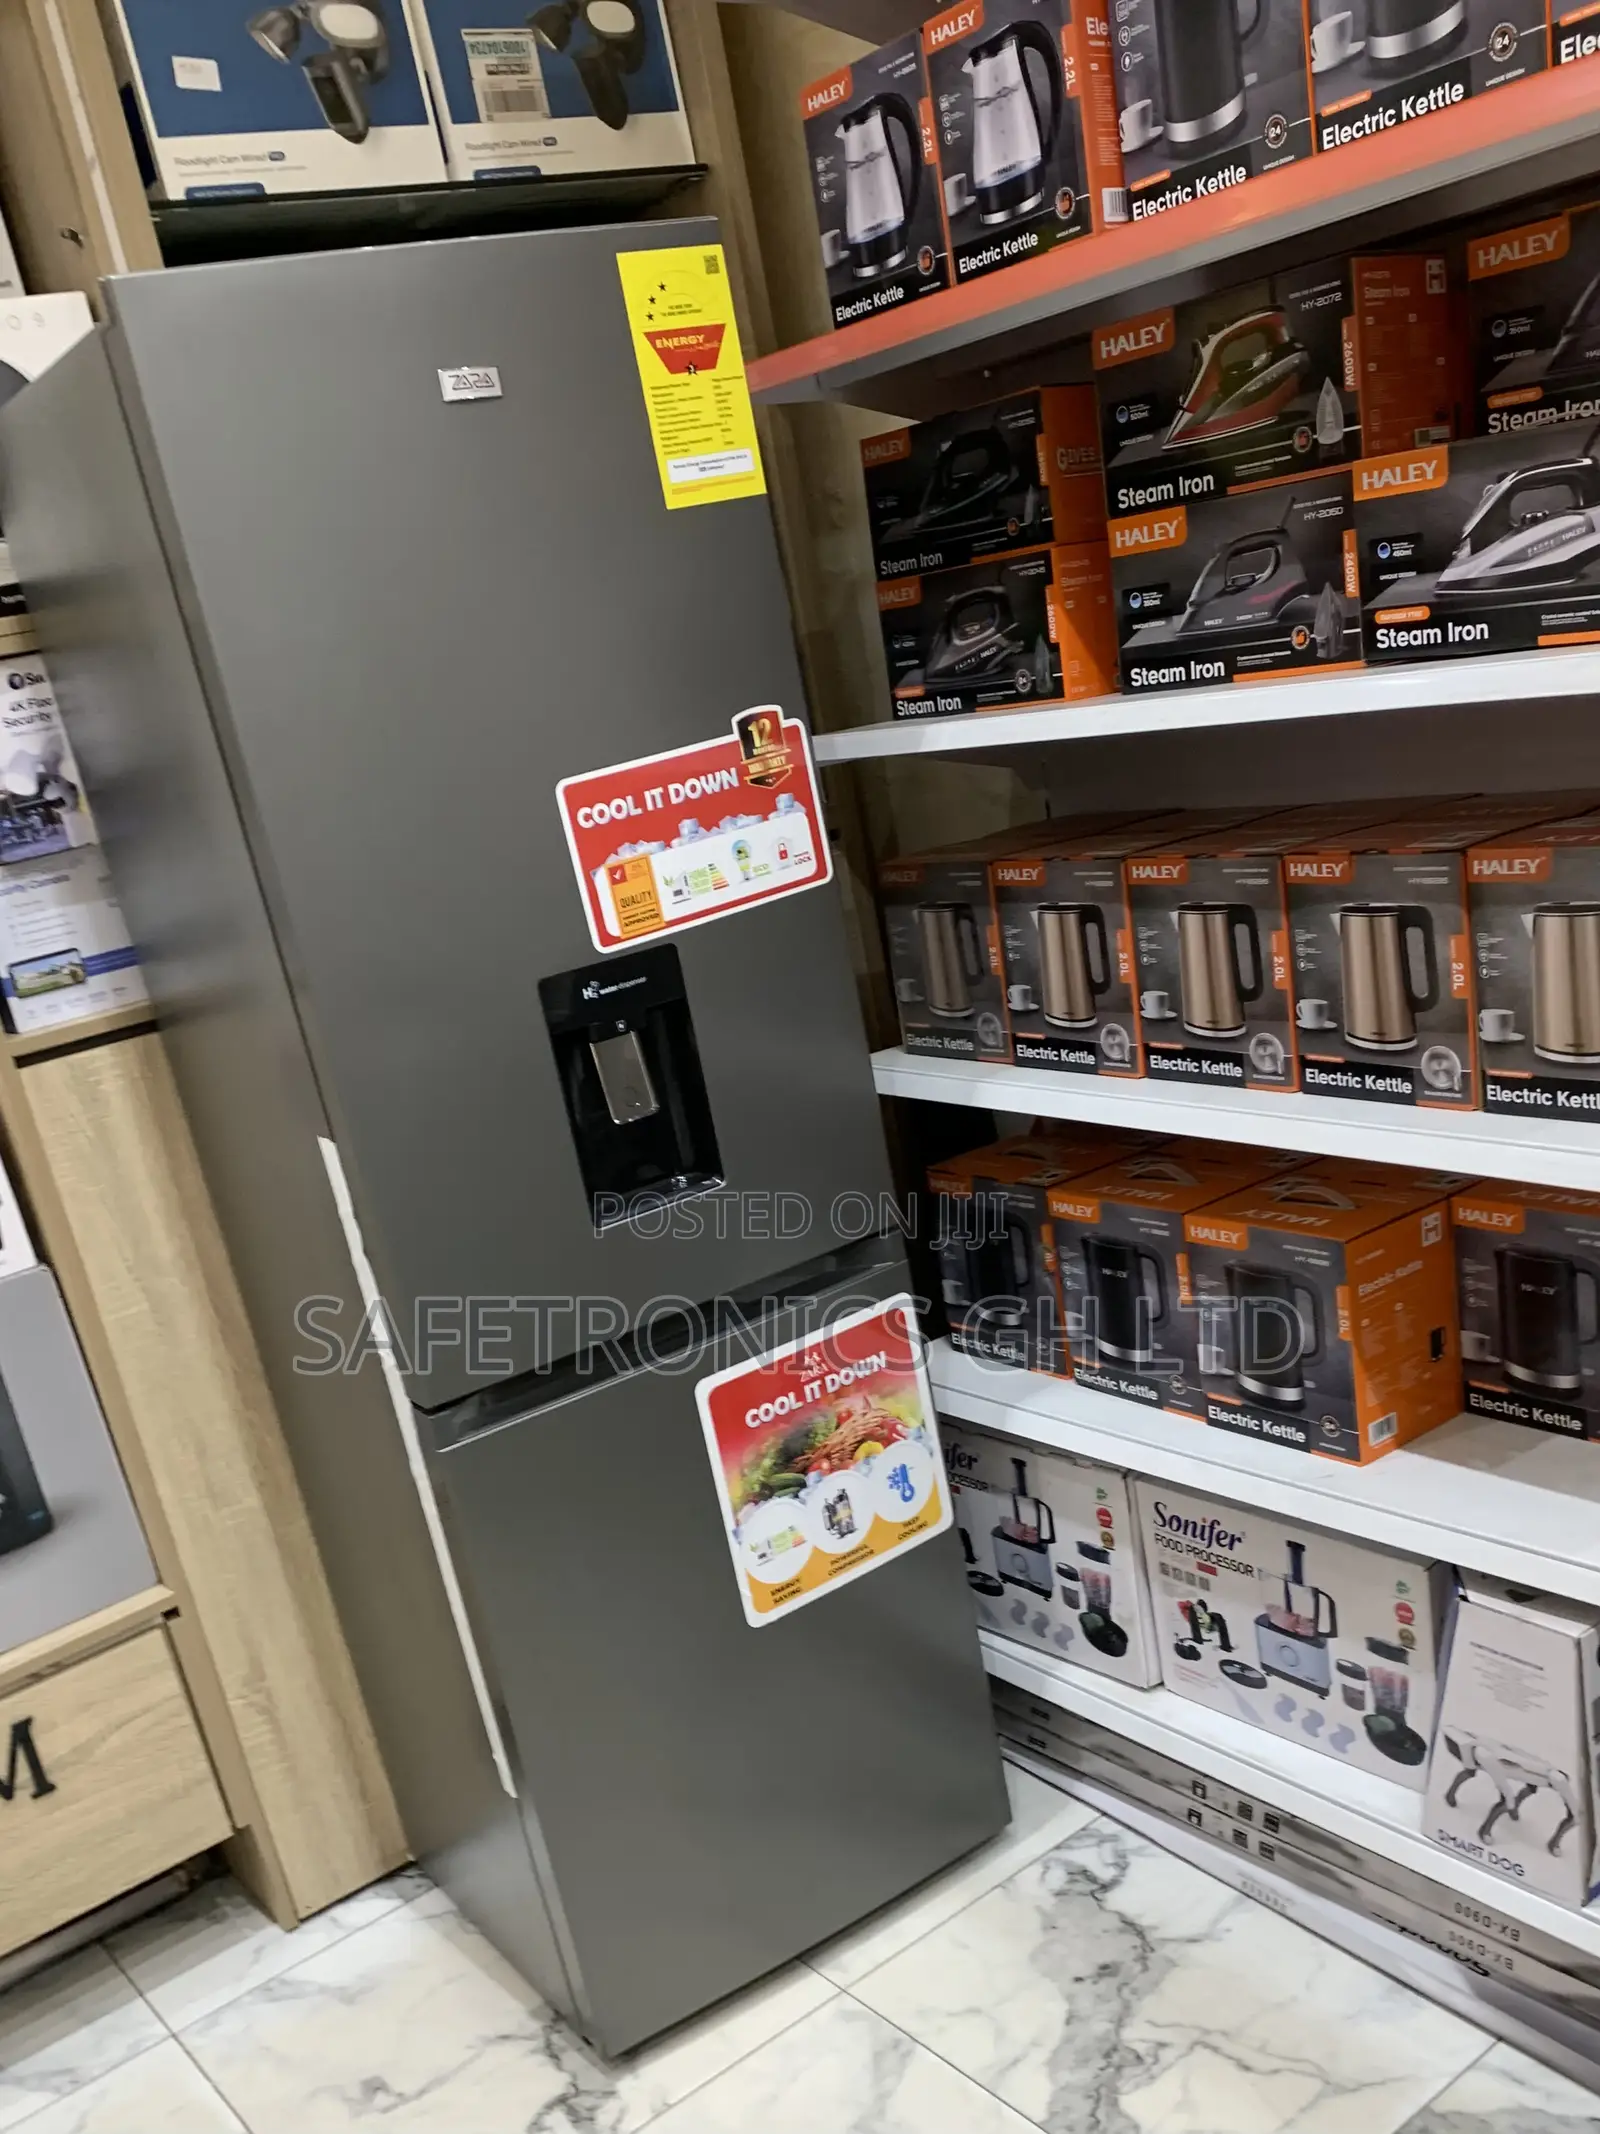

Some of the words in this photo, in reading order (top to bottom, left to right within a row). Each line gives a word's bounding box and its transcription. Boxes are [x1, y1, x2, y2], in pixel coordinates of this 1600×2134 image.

[930, 9, 976, 45] HALEY
[1085, 17, 1110, 36] Ele
[1064, 56, 1077, 91] 2.2L
[807, 80, 848, 111] HALEY
[1322, 107, 1397, 151] Electric
[1401, 81, 1465, 120] Kettle
[1132, 184, 1192, 221] Electric
[1196, 164, 1247, 198] Kettle
[959, 248, 1001, 274] Electric
[1000, 232, 1039, 258] Kettle
[1478, 230, 1559, 269] HALEY
[835, 298, 873, 322] Electric
[874, 286, 904, 311] Kettle
[1301, 292, 1343, 312] HY-2072
[655, 334, 705, 350] ENERGY
[1101, 321, 1165, 360] HALEY
[1344, 341, 1356, 387] 2600W
[1488, 407, 1557, 434] Steam
[1362, 460, 1437, 491] HALEY
[1117, 480, 1174, 509] Steam
[1179, 474, 1214, 496] Iron
[1116, 520, 1177, 548] HALEY
[880, 558, 917, 576] Steam
[920, 552, 943, 567] Iron
[1345, 552, 1356, 592] 2400W
[1375, 627, 1442, 649] Steam
[1448, 622, 1489, 643] Iron
[1130, 663, 1186, 687] Steam
[1191, 660, 1225, 680] Iron
[896, 700, 933, 716] Steam
[937, 696, 962, 711] Iron
[748, 718, 773, 748] 12
[577, 796, 642, 829] COOL
[643, 787, 665, 811] IT
[668, 767, 740, 804] DOWN
[998, 868, 1038, 881] HALEY
[1132, 866, 1180, 878] HALEY
[1289, 863, 1342, 877] HALEY
[1473, 859, 1540, 875] HALEY
[620, 890, 653, 909] QUALITY
[1119, 952, 1130, 977] 2.0L
[1274, 956, 1285, 982] 2.0L
[1452, 962, 1465, 991] 2.0L
[906, 1034, 941, 1049] Electric
[943, 1037, 974, 1051] Kettle
[1017, 1045, 1058, 1061] Electric
[1061, 1049, 1095, 1065] Kettle
[1150, 1056, 1199, 1073] Electric
[1201, 1060, 1243, 1077] Kettle
[1305, 1068, 1361, 1088] Electric
[1364, 1075, 1413, 1095] Kettle
[1487, 1084, 1553, 1105] Electric
[1557, 1090, 1600, 1110] Kettl
[1053, 1202, 1095, 1217] HALEY
[1458, 1207, 1513, 1226] HALEY
[1190, 1226, 1240, 1244] HALEY
[952, 1333, 990, 1353] Electric
[744, 1391, 804, 1428] COOL
[803, 1379, 822, 1404] IT
[825, 1350, 887, 1392] DOWN
[1074, 1368, 1118, 1391] Electric
[1120, 1378, 1158, 1400] Kettle
[1208, 1405, 1260, 1431] Electric
[1262, 1418, 1306, 1444] Kettle
[1469, 1394, 1529, 1420] Electric
[1533, 1407, 1583, 1431] Kettle
[1153, 1502, 1243, 1551] Sonifer
[1154, 1532, 1184, 1554] FOOD
[1186, 1543, 1255, 1579] PROCESSOR
[1437, 1828, 1484, 1859] SMART
[1487, 1850, 1525, 1877] DOG
